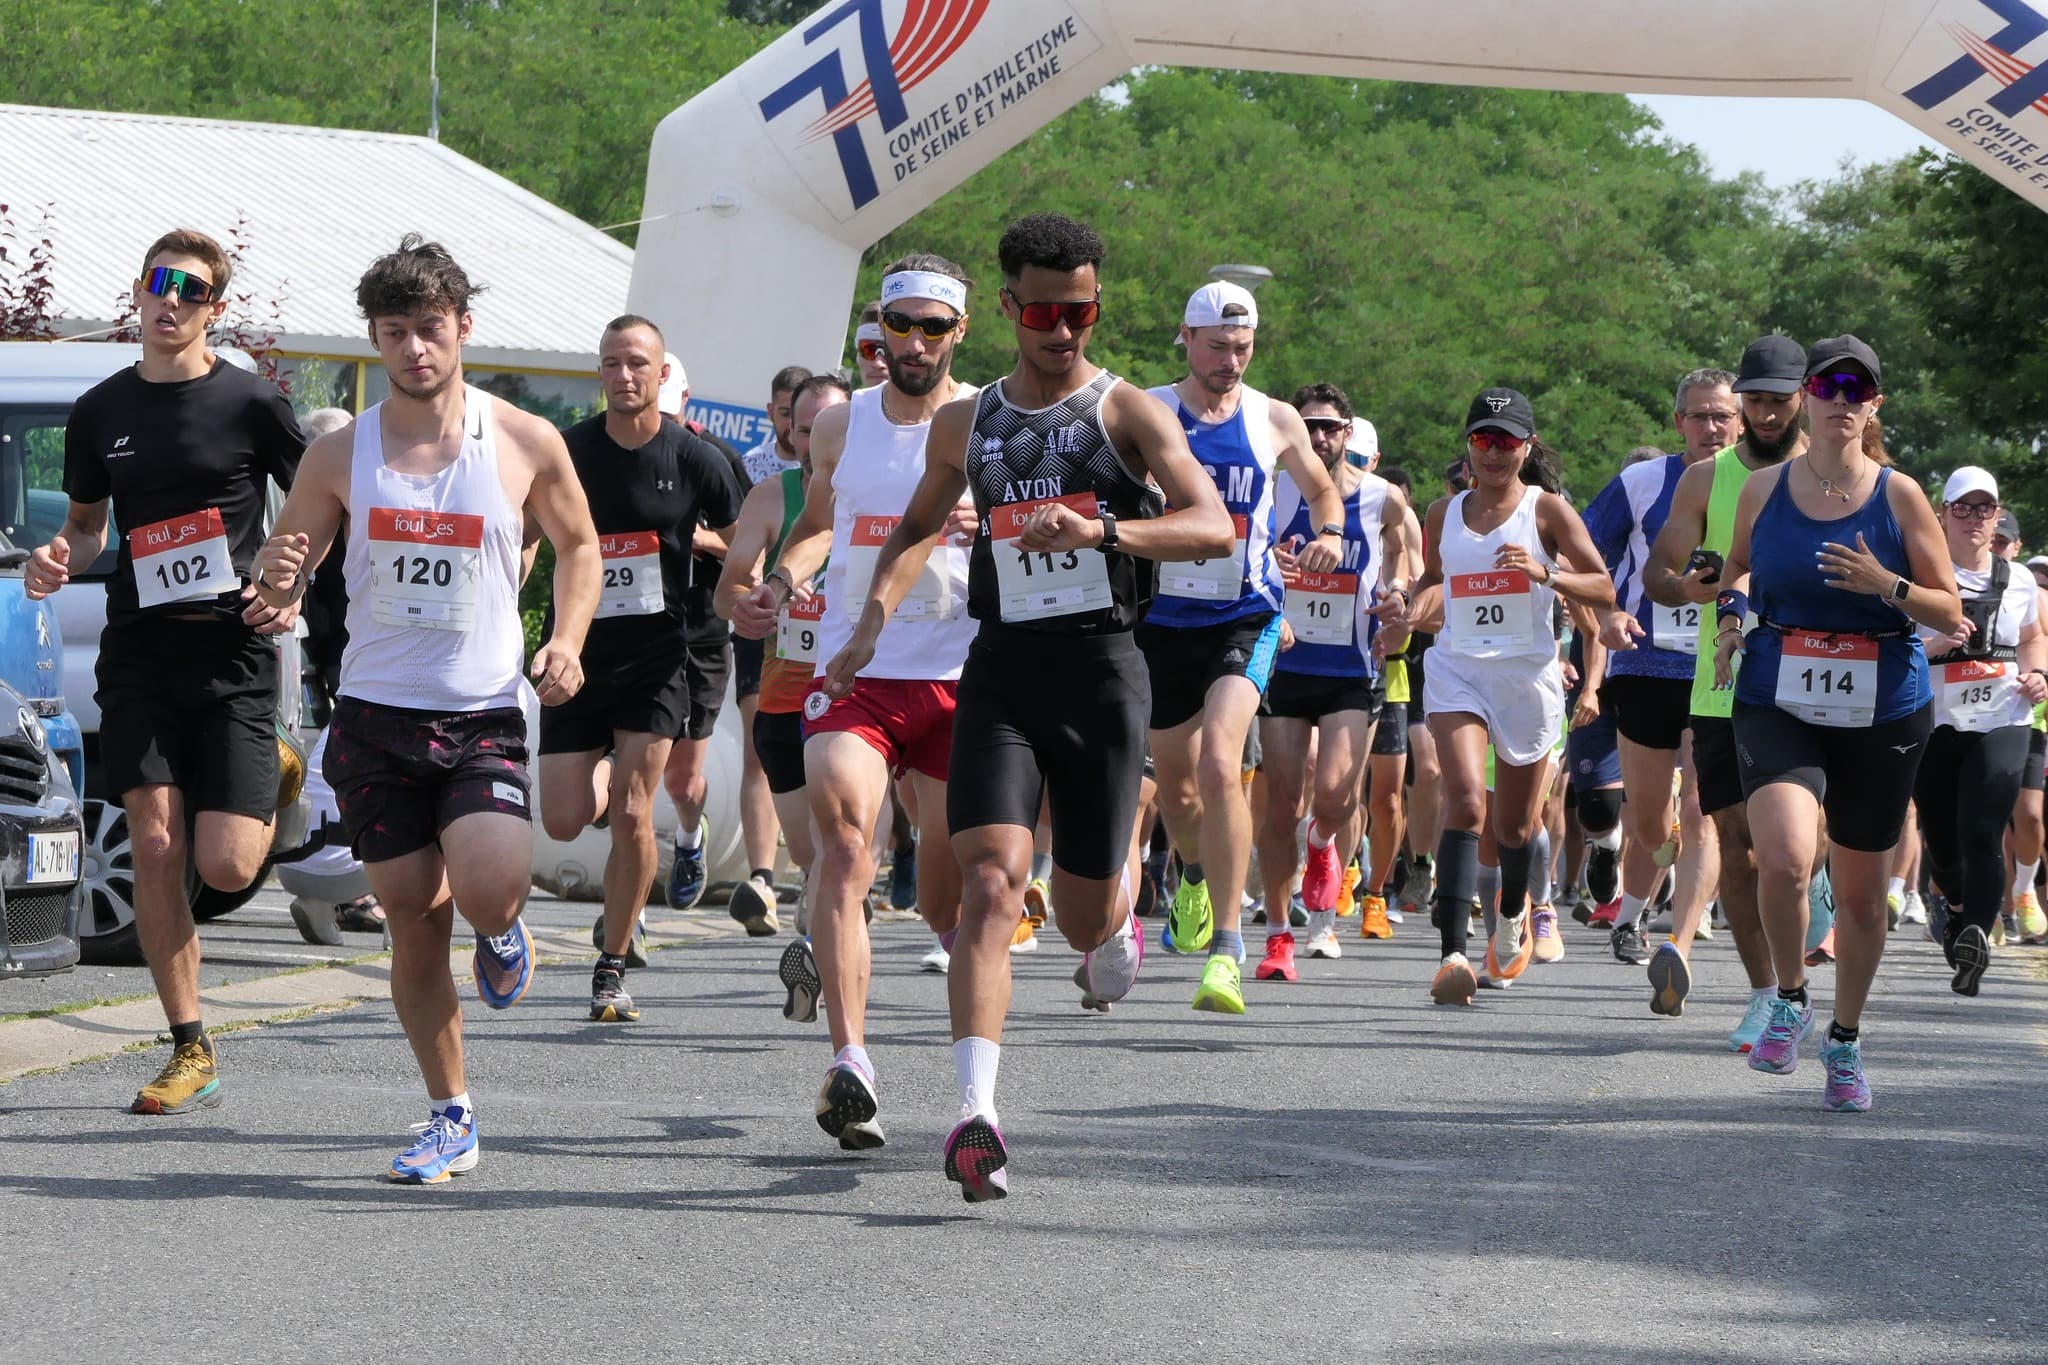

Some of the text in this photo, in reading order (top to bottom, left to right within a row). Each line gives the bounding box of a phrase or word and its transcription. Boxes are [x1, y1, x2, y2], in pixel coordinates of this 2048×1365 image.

[889, 16, 1077, 158] COMITE D'ATHLETISME
[894, 55, 1061, 181] DE SEINE ET MARNE
[1966, 108, 2039, 156] COMITE
[1945, 117, 1977, 137] DE
[1973, 137, 2032, 173] SEINE
[686, 405, 755, 443] MARNE
[1003, 476, 1061, 502] AVON
[869, 520, 892, 537] foul
[156, 555, 211, 589] 102
[392, 555, 452, 587] 120
[604, 567, 634, 589] 29
[1306, 600, 1331, 618] 10
[1475, 604, 1504, 626] 20
[1801, 668, 1855, 695] 114
[1961, 685, 1993, 705] 135
